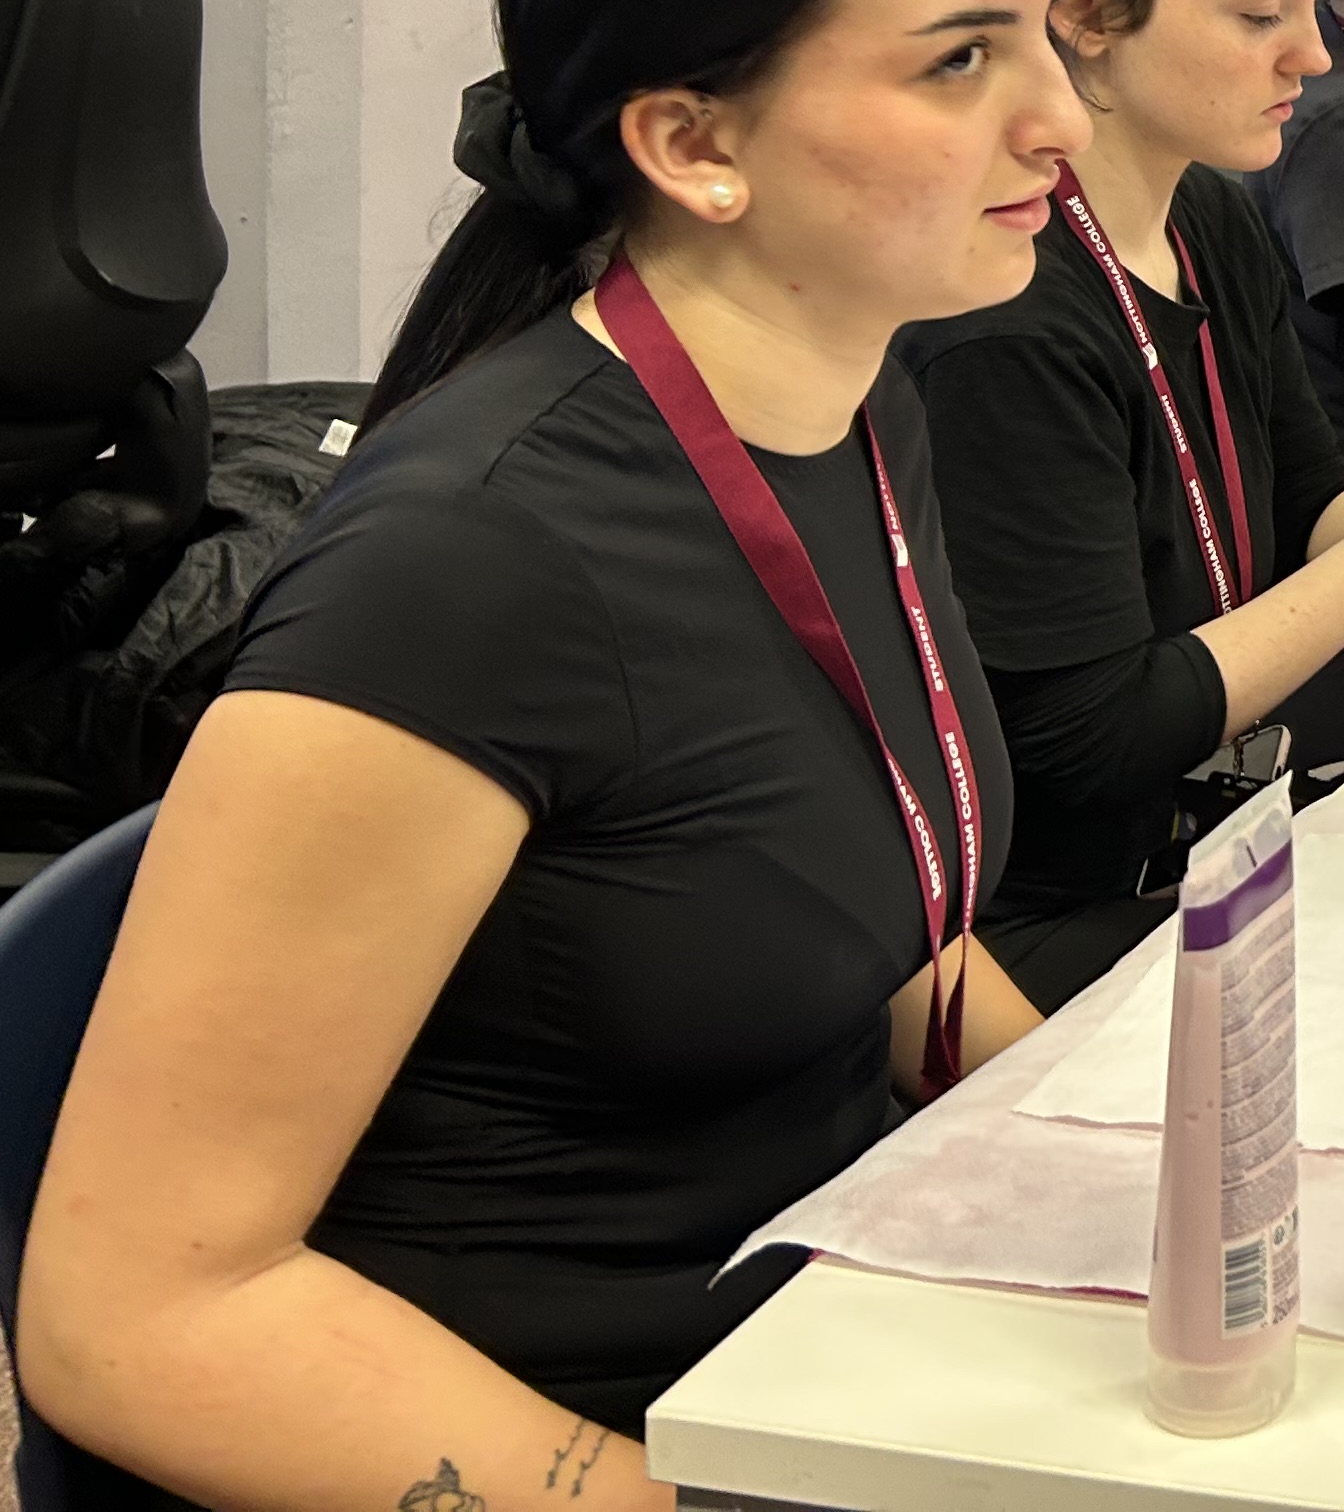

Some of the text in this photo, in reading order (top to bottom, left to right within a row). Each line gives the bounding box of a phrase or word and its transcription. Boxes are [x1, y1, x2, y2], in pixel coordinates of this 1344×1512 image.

[1066, 195, 1148, 344] NOTTINGHAM COLLEGE
[1161, 394, 1188, 454] STUDENT
[1189, 478, 1232, 615] OTTINGHAM COLLEGE
[911, 605, 944, 692] STUDENT
